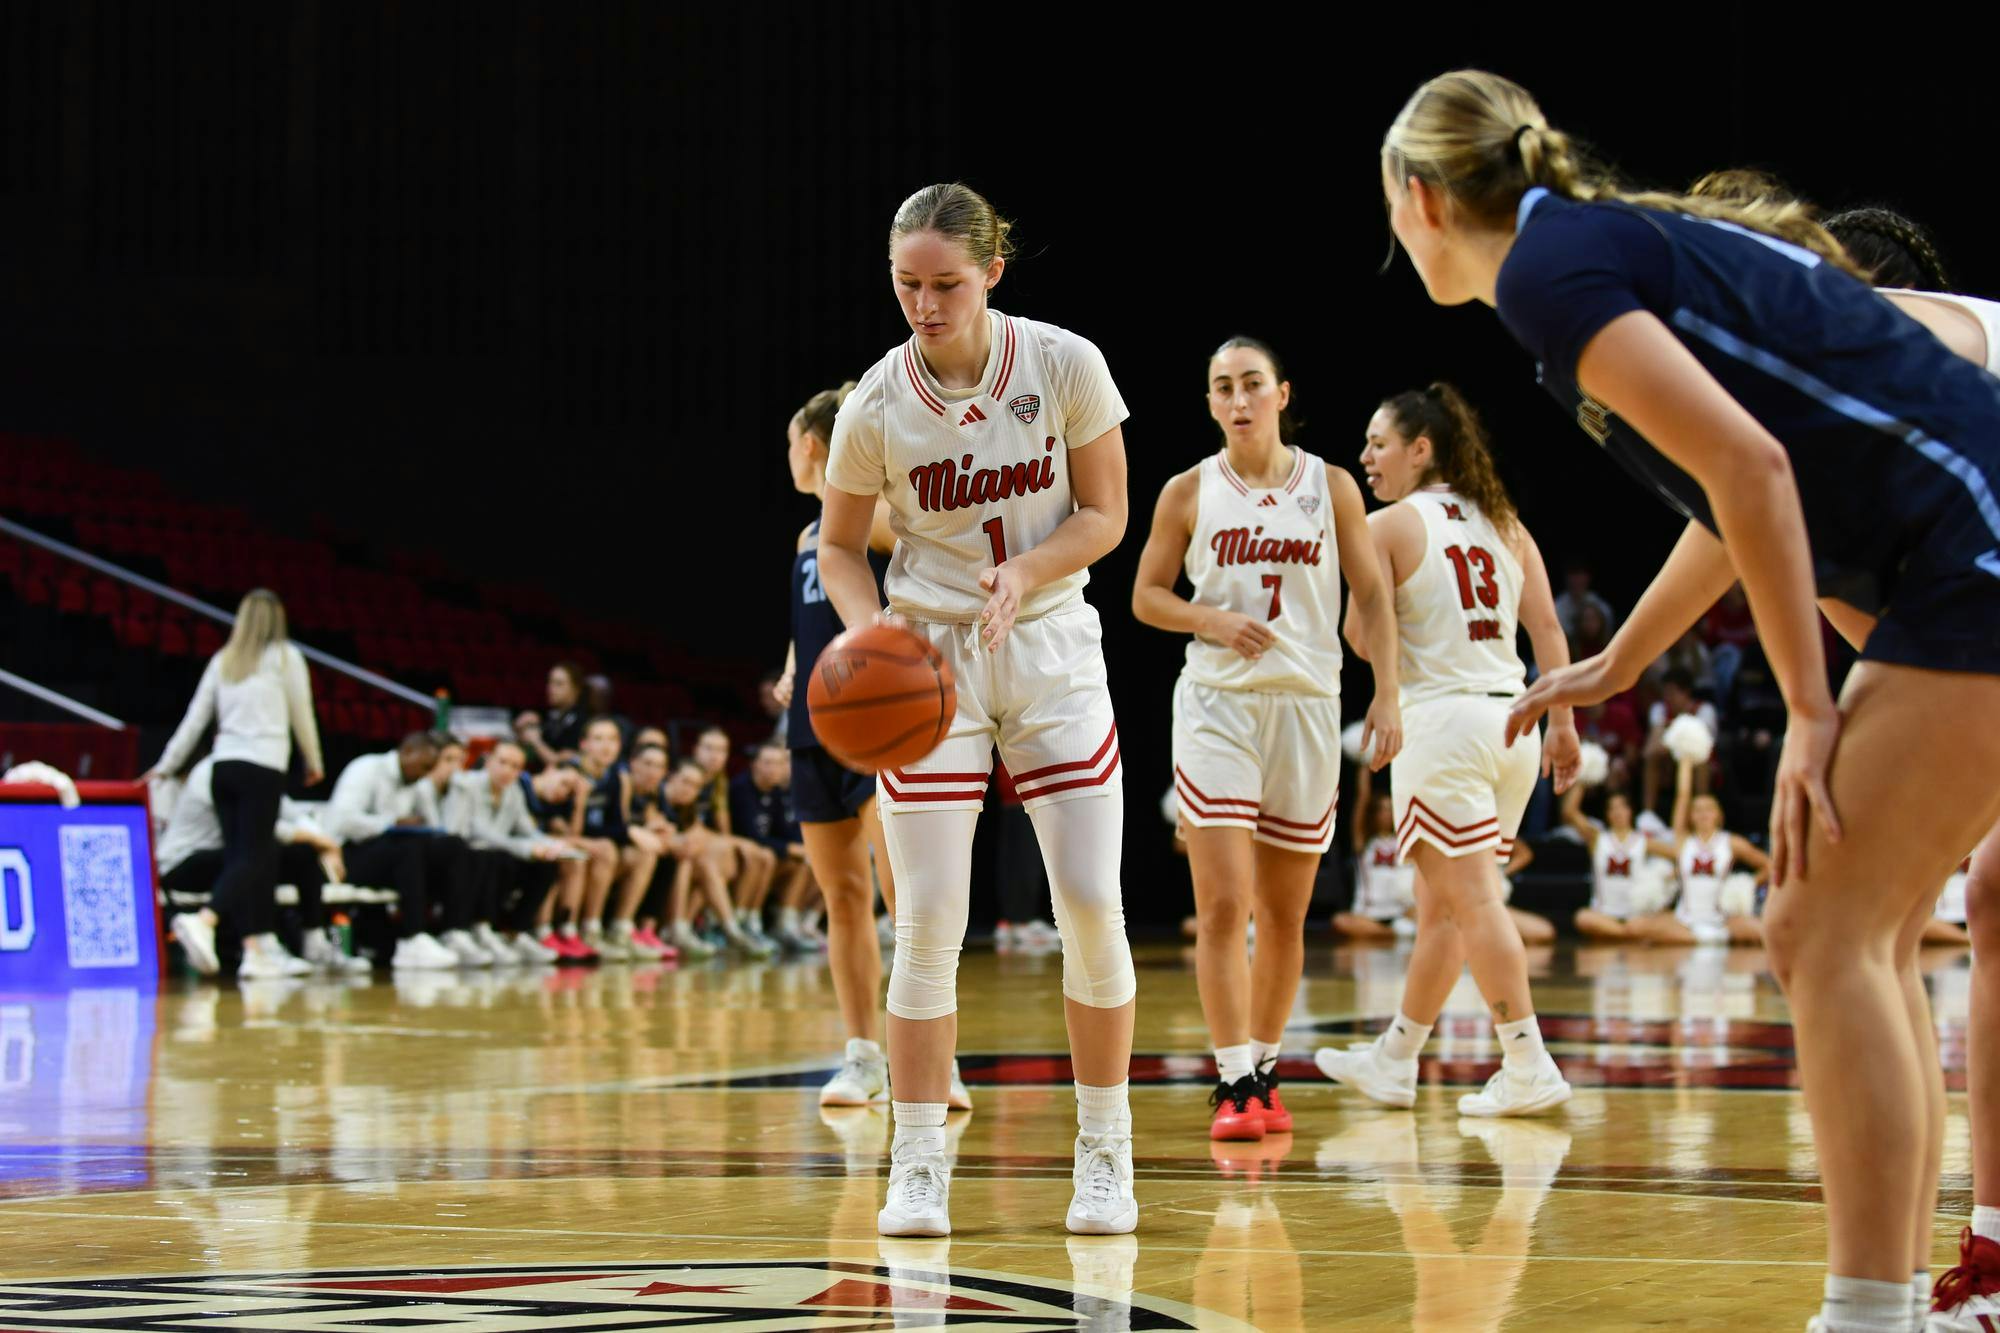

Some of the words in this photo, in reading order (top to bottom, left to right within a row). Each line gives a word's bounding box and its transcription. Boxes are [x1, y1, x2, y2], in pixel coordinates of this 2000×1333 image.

[1013, 402, 1039, 415] MAC
[909, 436, 1055, 512] Miami
[982, 516, 1007, 568] 1
[1211, 525, 1324, 567] Miami
[1261, 574, 1282, 622] 7
[1445, 544, 1499, 610] 13
[1607, 856, 1630, 876] M
[1692, 857, 1715, 875] M
